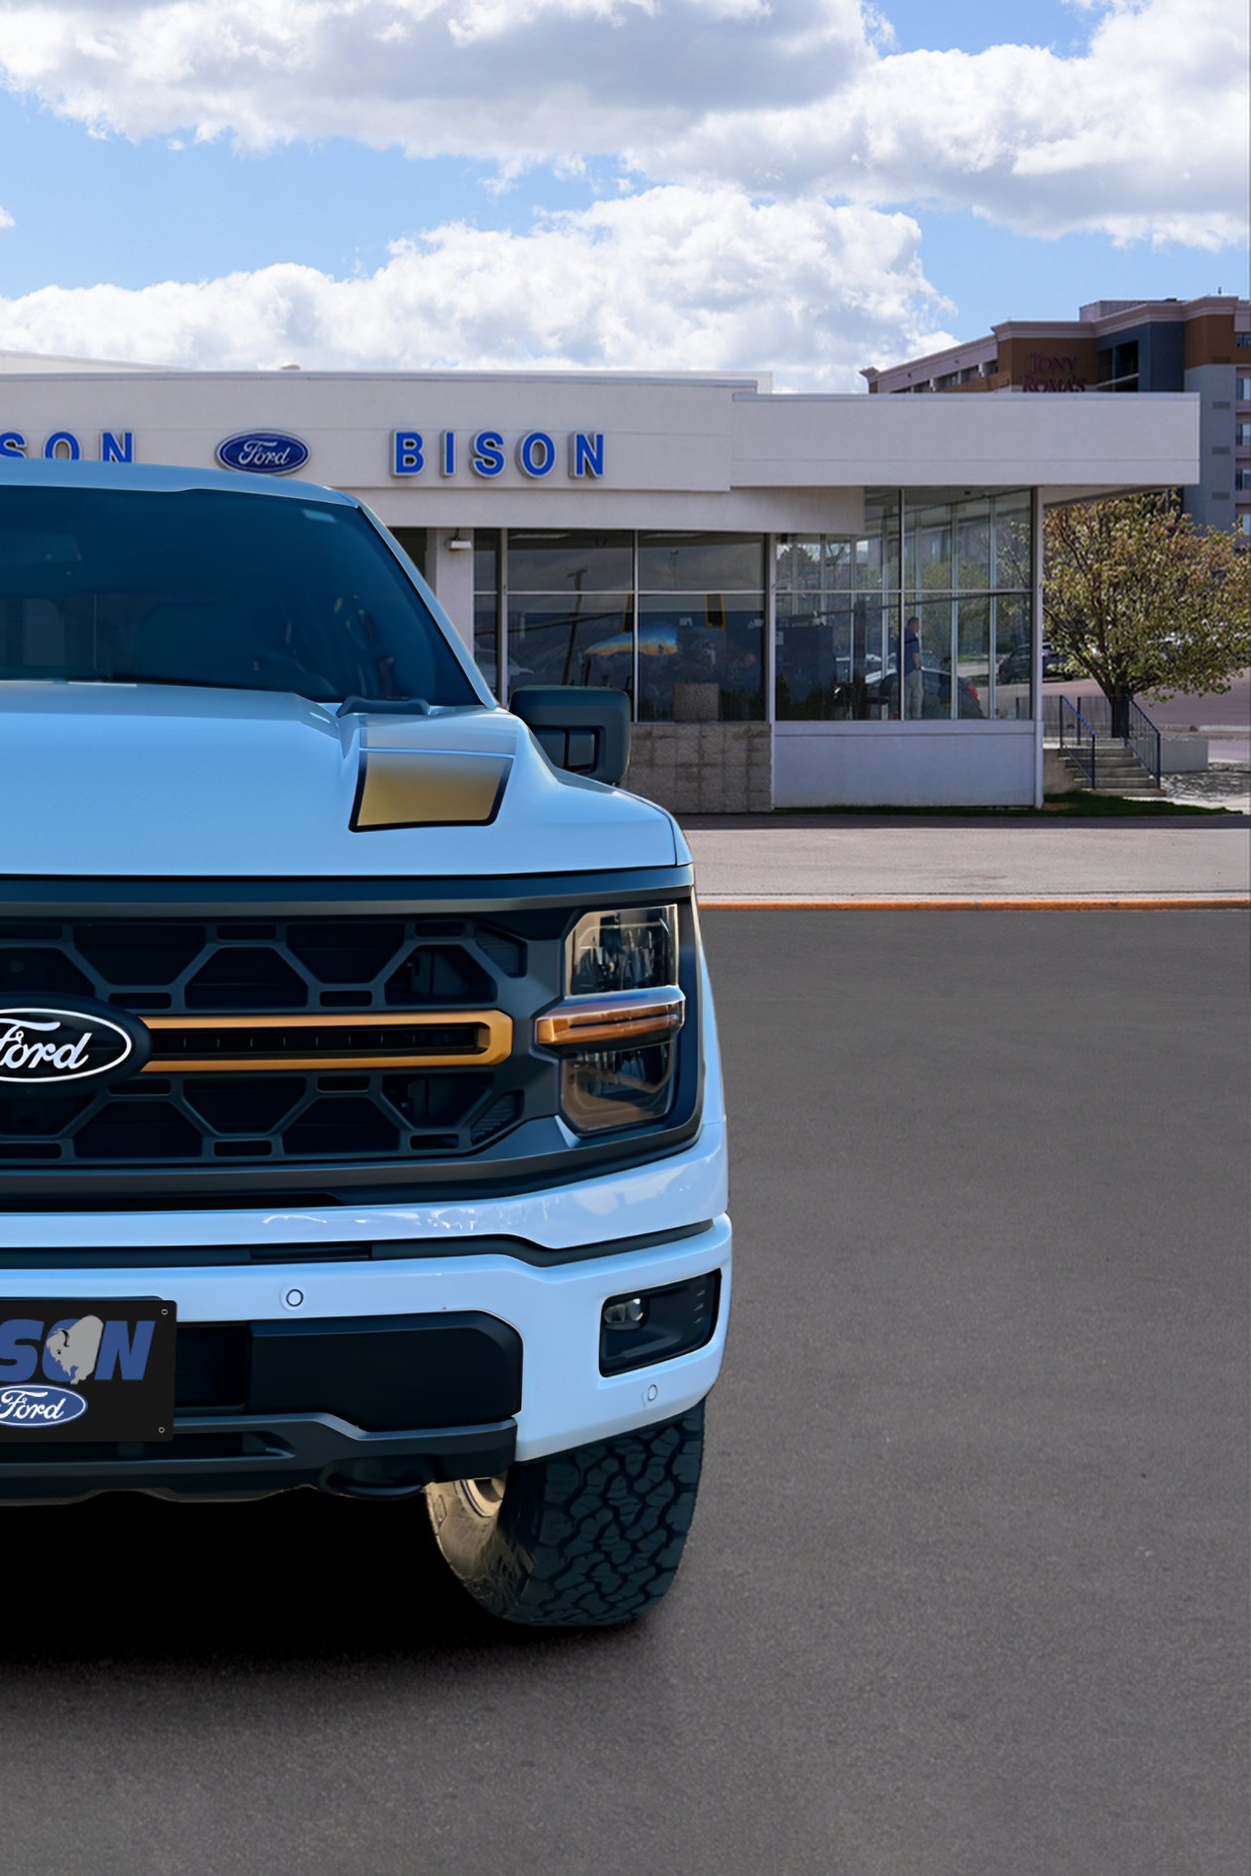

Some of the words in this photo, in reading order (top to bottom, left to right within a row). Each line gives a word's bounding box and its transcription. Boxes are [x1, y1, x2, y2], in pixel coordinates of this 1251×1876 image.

[1026, 352, 1077, 374] TONY
[238, 440, 291, 465] Ford
[393, 430, 605, 477] BISON
